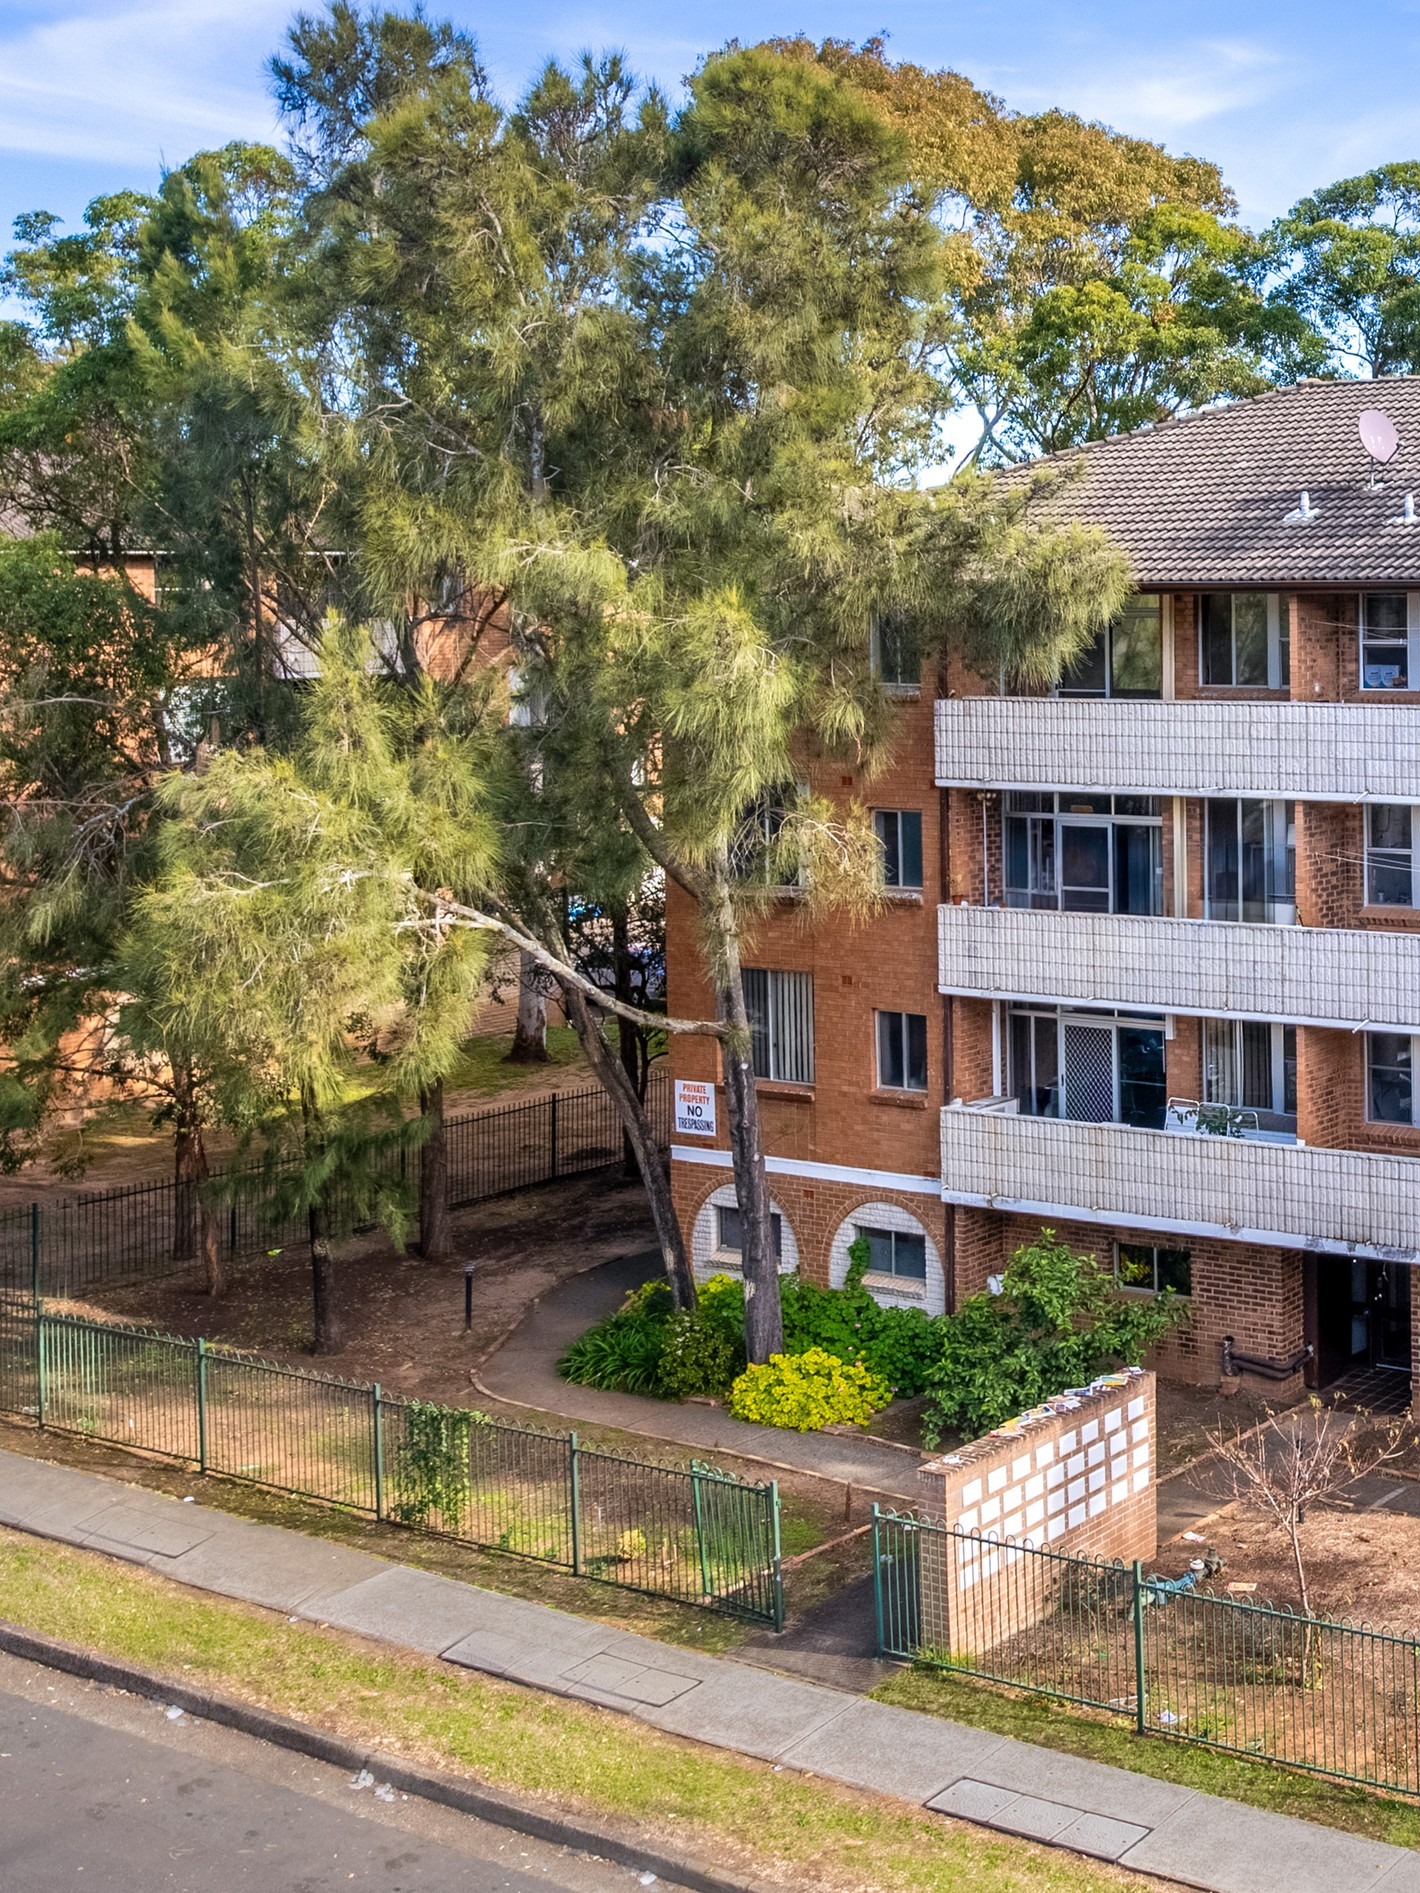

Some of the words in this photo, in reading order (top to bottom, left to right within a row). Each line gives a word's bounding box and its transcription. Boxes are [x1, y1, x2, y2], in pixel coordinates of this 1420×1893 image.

[683, 1083, 706, 1094] PRIVATE
[679, 1093, 709, 1105] PROPERTY
[687, 1105, 703, 1117] NO
[678, 1117, 714, 1132] TRESPASSING
